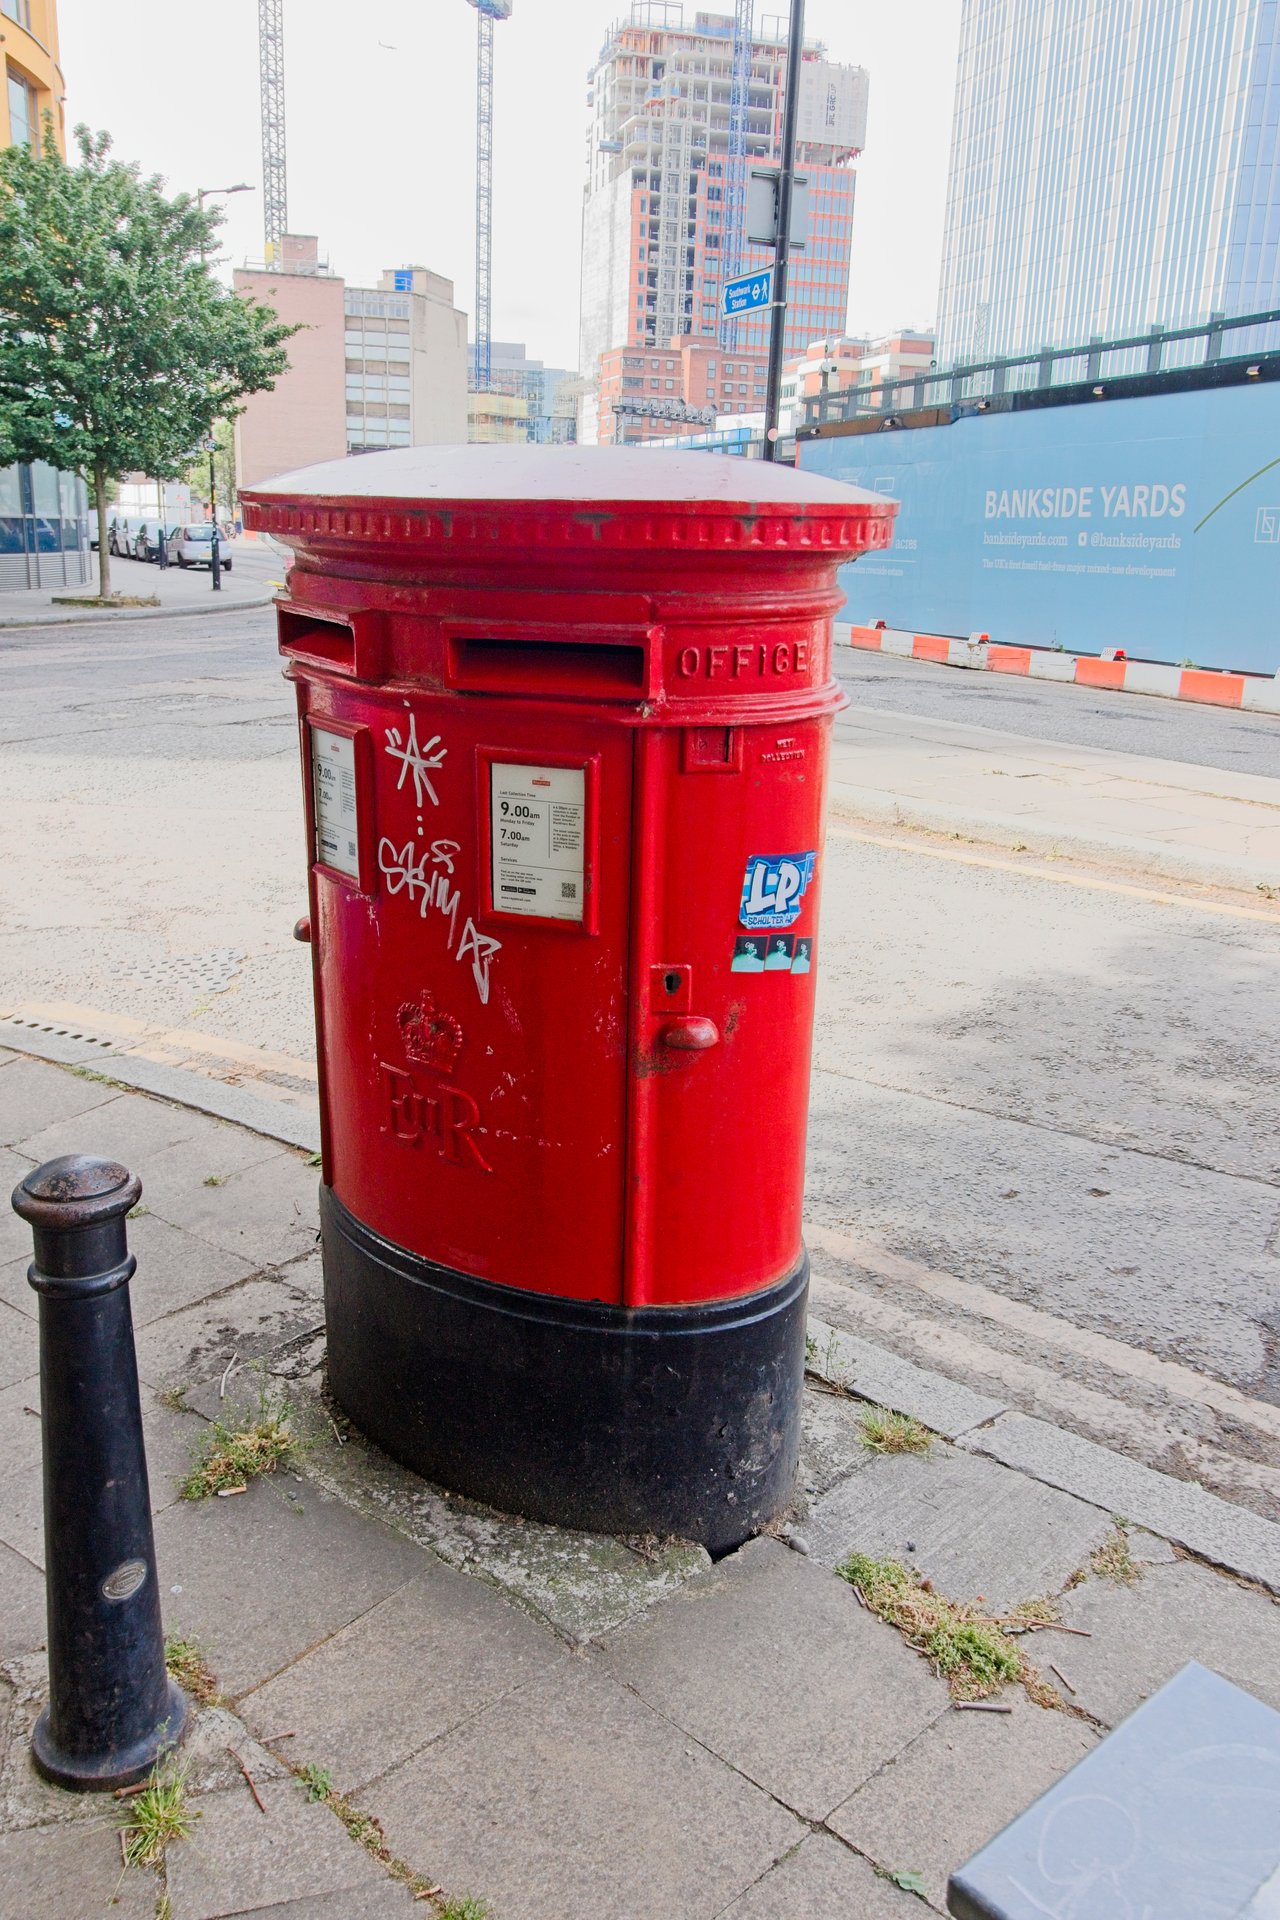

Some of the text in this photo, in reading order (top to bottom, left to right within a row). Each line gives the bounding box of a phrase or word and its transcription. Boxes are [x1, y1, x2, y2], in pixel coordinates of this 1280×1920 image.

[731, 297, 747, 310] Station
[984, 483, 1187, 519] BANKSIDE YARDS
[983, 531, 1181, 552] banksideyards.com @banksideyards
[983, 558, 994, 569] The
[1008, 560, 1021, 570] first
[1066, 562, 1086, 575] major
[1087, 563, 1125, 576] mixed-use
[1125, 564, 1176, 579] development
[680, 640, 808, 677] OFFICE
[500, 801, 540, 819] 9.00am
[500, 828, 530, 841] 7.00am
[500, 841, 519, 849] Saturday
[745, 861, 801, 914] LP
